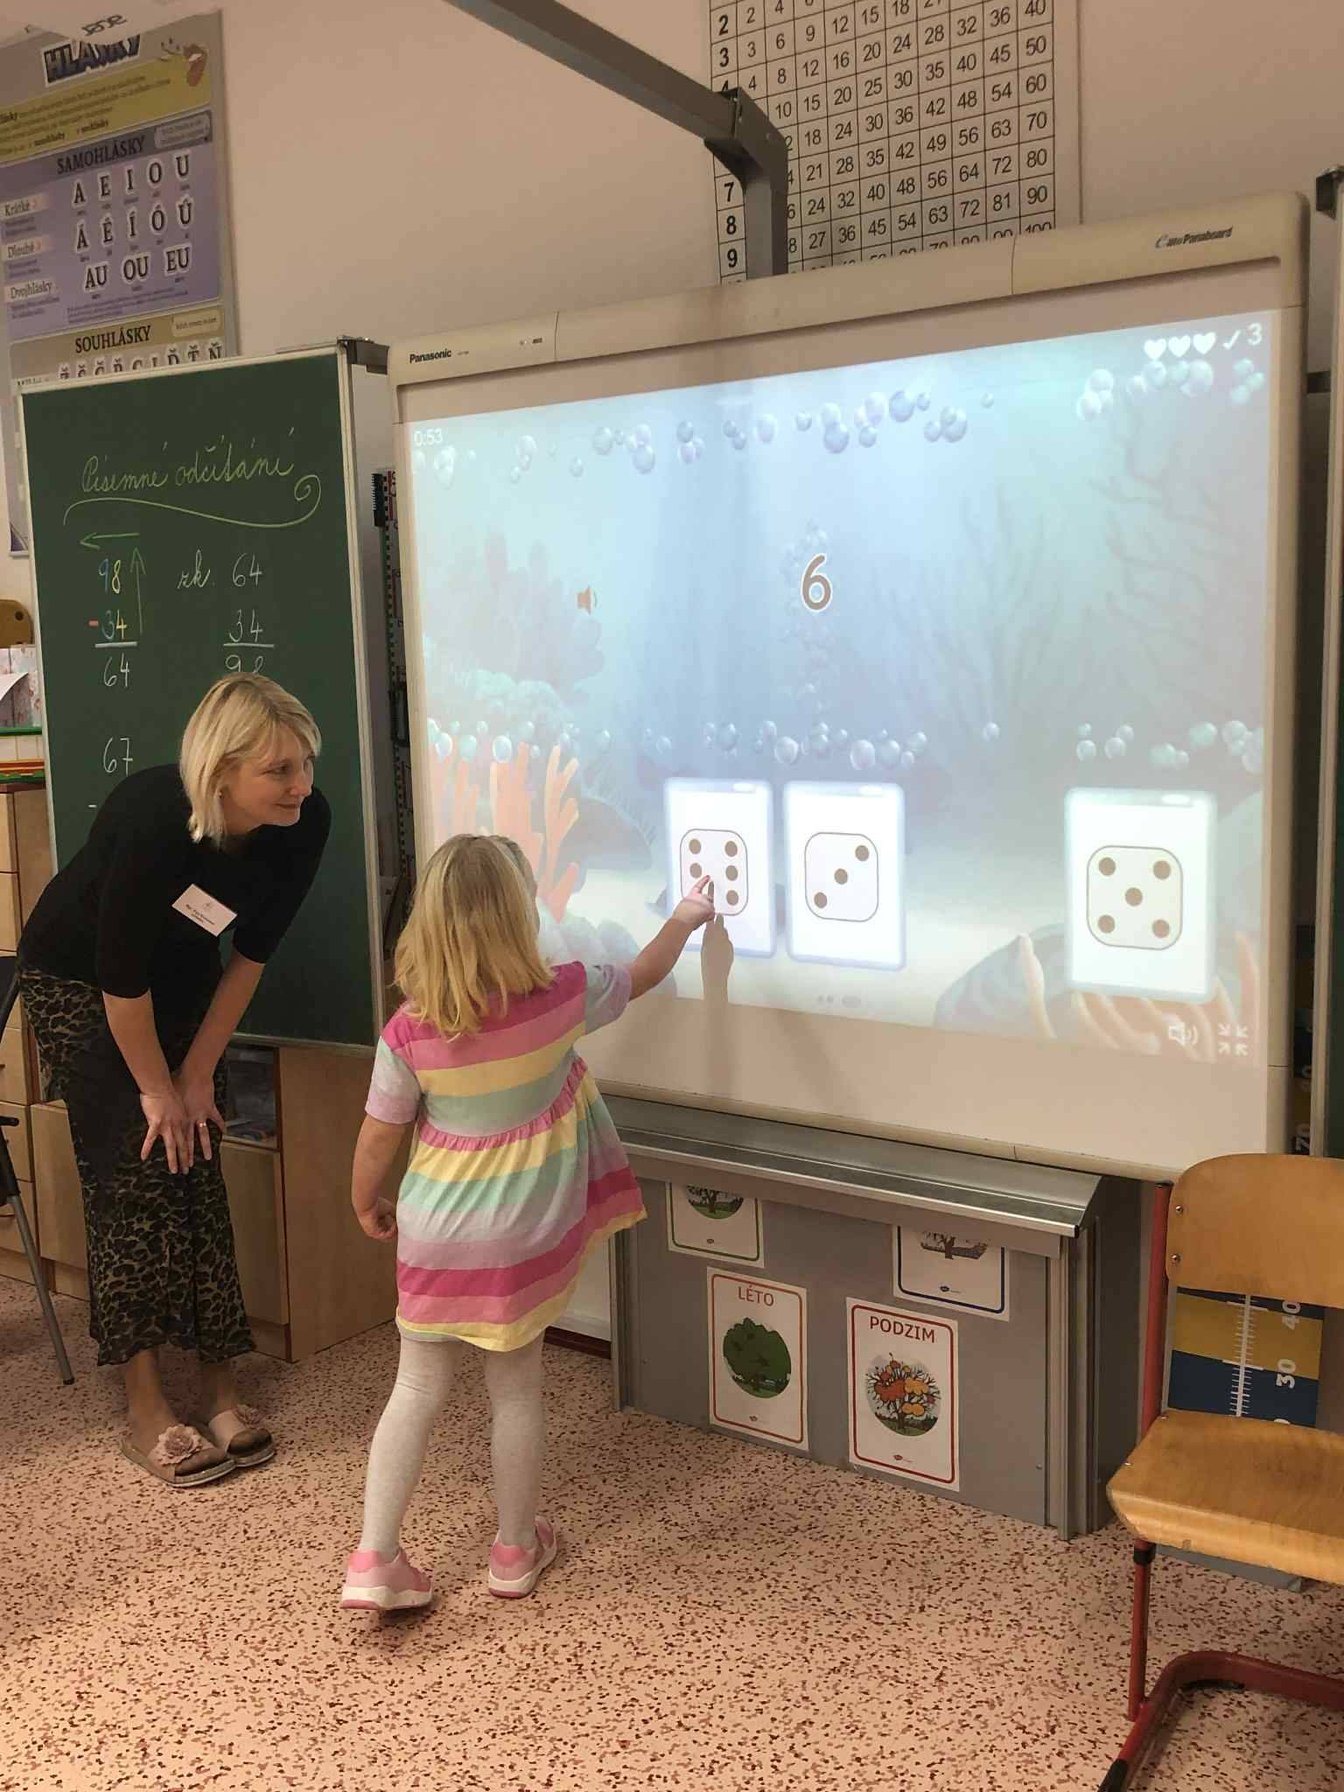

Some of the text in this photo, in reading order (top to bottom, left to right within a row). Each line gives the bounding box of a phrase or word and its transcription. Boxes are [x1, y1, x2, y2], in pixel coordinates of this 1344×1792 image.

[719, 0, 784, 36] 2 2 4
[720, 47, 729, 67] 3
[747, 41, 756, 58] 3
[776, 33, 785, 50] 6
[806, 25, 815, 42] 9
[832, 16, 848, 34] 12
[862, 6, 880, 26] 15
[892, 0, 910, 16] 18
[748, 76, 756, 91] 4
[778, 68, 786, 84] 8
[802, 59, 819, 77] 12
[833, 52, 850, 70] 16
[863, 42, 881, 62] 20
[892, 34, 911, 54] 24
[924, 24, 944, 45] 28
[956, 16, 977, 36] 32
[990, 6, 1010, 27] 36
[1024, 0, 1046, 17] 40
[776, 36, 1046, 120] 10 15 20 25 30 35 40 45 50
[804, 129, 821, 147] 18
[835, 121, 852, 140] 24
[865, 113, 884, 132] 30
[896, 106, 914, 125] 36
[926, 98, 946, 117] 42
[957, 90, 977, 109] 48
[992, 82, 1012, 102] 54
[1026, 73, 1046, 94] 60
[724, 182, 734, 202] 7
[806, 164, 822, 182] 21
[836, 156, 854, 175] 28
[866, 149, 884, 167] 35
[896, 142, 914, 160] 42
[926, 134, 946, 152] 49
[958, 126, 978, 146] 56
[992, 119, 1012, 138] 63
[1026, 111, 1047, 131] 70
[74, 154, 190, 204] A E I O U
[726, 216, 736, 235] 8
[808, 197, 825, 216] 24
[838, 190, 854, 209] 32
[867, 184, 885, 201] 40
[896, 177, 916, 195] 48
[928, 170, 947, 188] 56
[959, 163, 979, 182] 64
[992, 156, 1012, 175] 72
[1026, 148, 1047, 168] 80
[76, 224, 88, 249] Á
[104, 217, 113, 243] É
[129, 211, 136, 237] Í
[152, 204, 165, 232] Ó
[727, 248, 738, 268] 9
[809, 232, 826, 250] 27
[838, 225, 856, 244] 36
[868, 218, 886, 236] 45
[898, 212, 916, 231] 54
[928, 206, 948, 224] 63
[960, 199, 980, 218] 72
[992, 192, 1010, 212] 81
[1028, 186, 1048, 205] 90
[85, 247, 190, 289] AU OU EU
[75, 325, 151, 354] SOUHLÁSKY
[1248, 323, 1262, 346] 3
[410, 348, 452, 364] Panasonic
[414, 428, 443, 447] 0:53
[99, 558, 122, 594] 98
[232, 553, 262, 588] 64
[801, 554, 832, 612] 6
[229, 609, 263, 643] 34
[104, 653, 130, 688] 64
[104, 737, 134, 777] 67
[738, 1284, 774, 1308] LÉTO
[870, 1315, 936, 1344] PODZIM
[1276, 1358, 1296, 1389] 30
